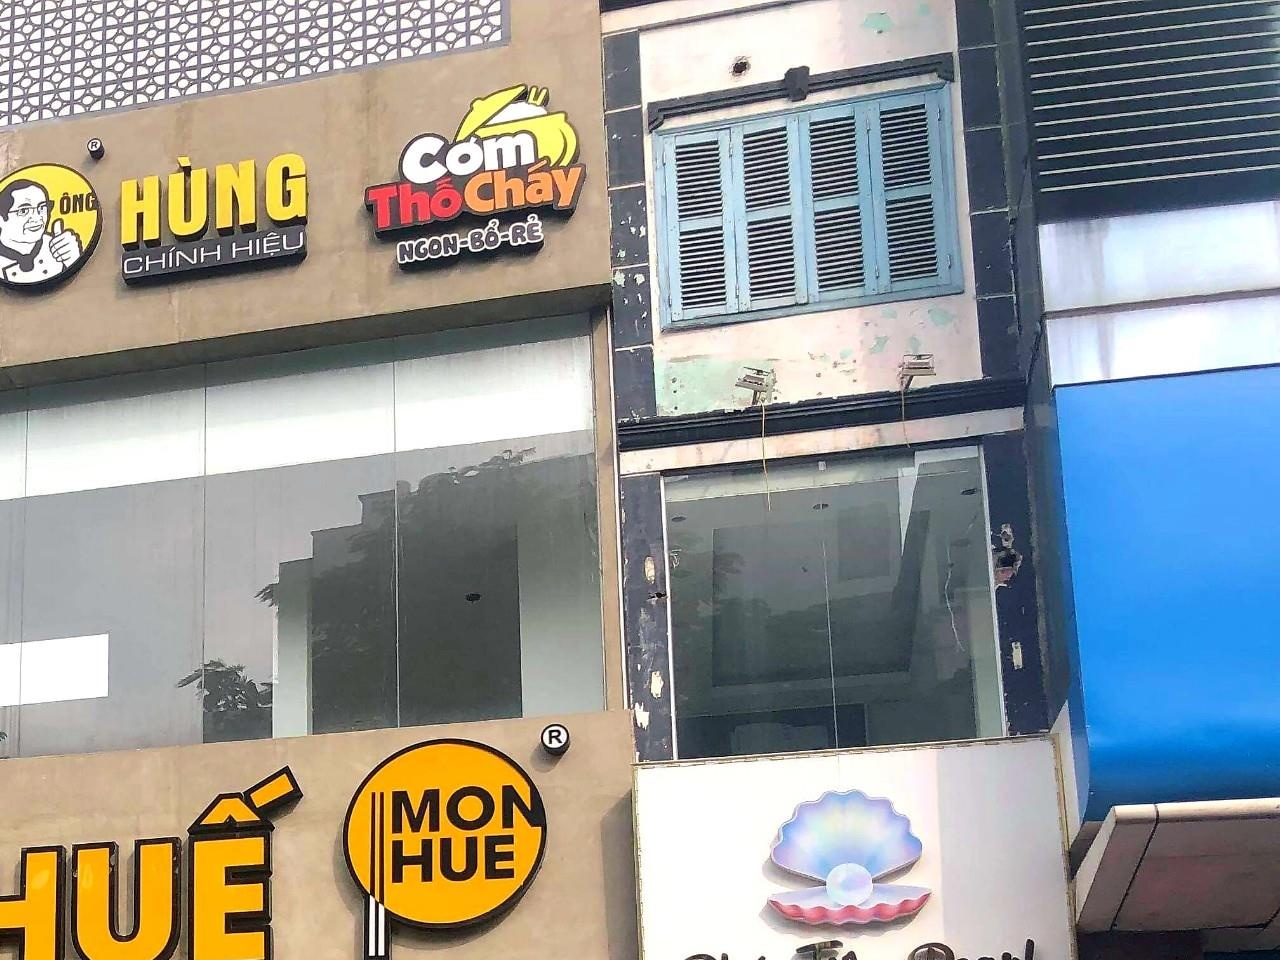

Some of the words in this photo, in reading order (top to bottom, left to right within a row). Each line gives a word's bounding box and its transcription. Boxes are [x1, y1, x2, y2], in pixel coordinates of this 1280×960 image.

[59, 192, 97, 217] ÔNG
[121, 153, 308, 245] HÙNG
[368, 177, 463, 229] Thố
[464, 160, 582, 213] Cháy
[123, 246, 222, 276] CHÍNH
[231, 231, 305, 258] HIỆU
[390, 784, 544, 834] MON
[390, 834, 517, 884] HUE
